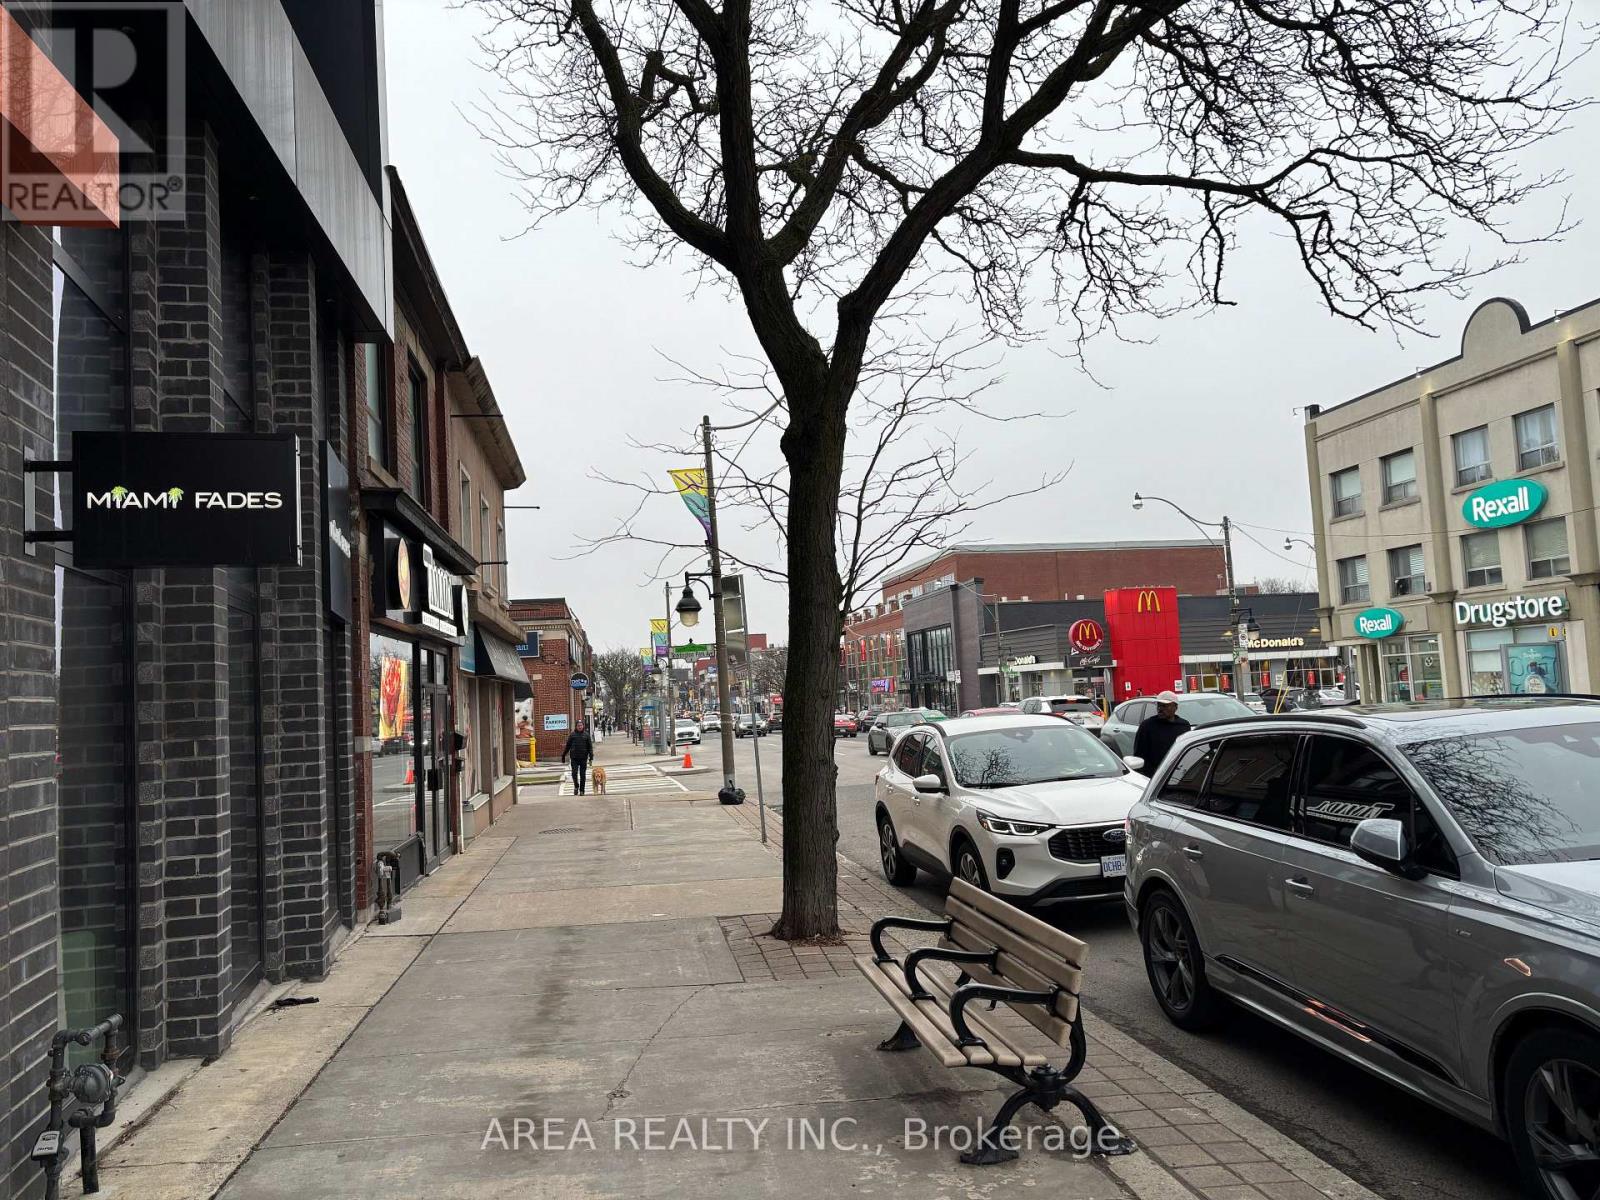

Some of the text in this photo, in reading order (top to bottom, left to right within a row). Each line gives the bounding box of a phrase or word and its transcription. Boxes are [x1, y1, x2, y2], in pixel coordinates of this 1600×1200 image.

[86, 485, 283, 509] MIAMI FADES
[1472, 486, 1530, 522] Rexall
[1359, 613, 1393, 634] Rexall
[1455, 595, 1563, 628] Drugstore
